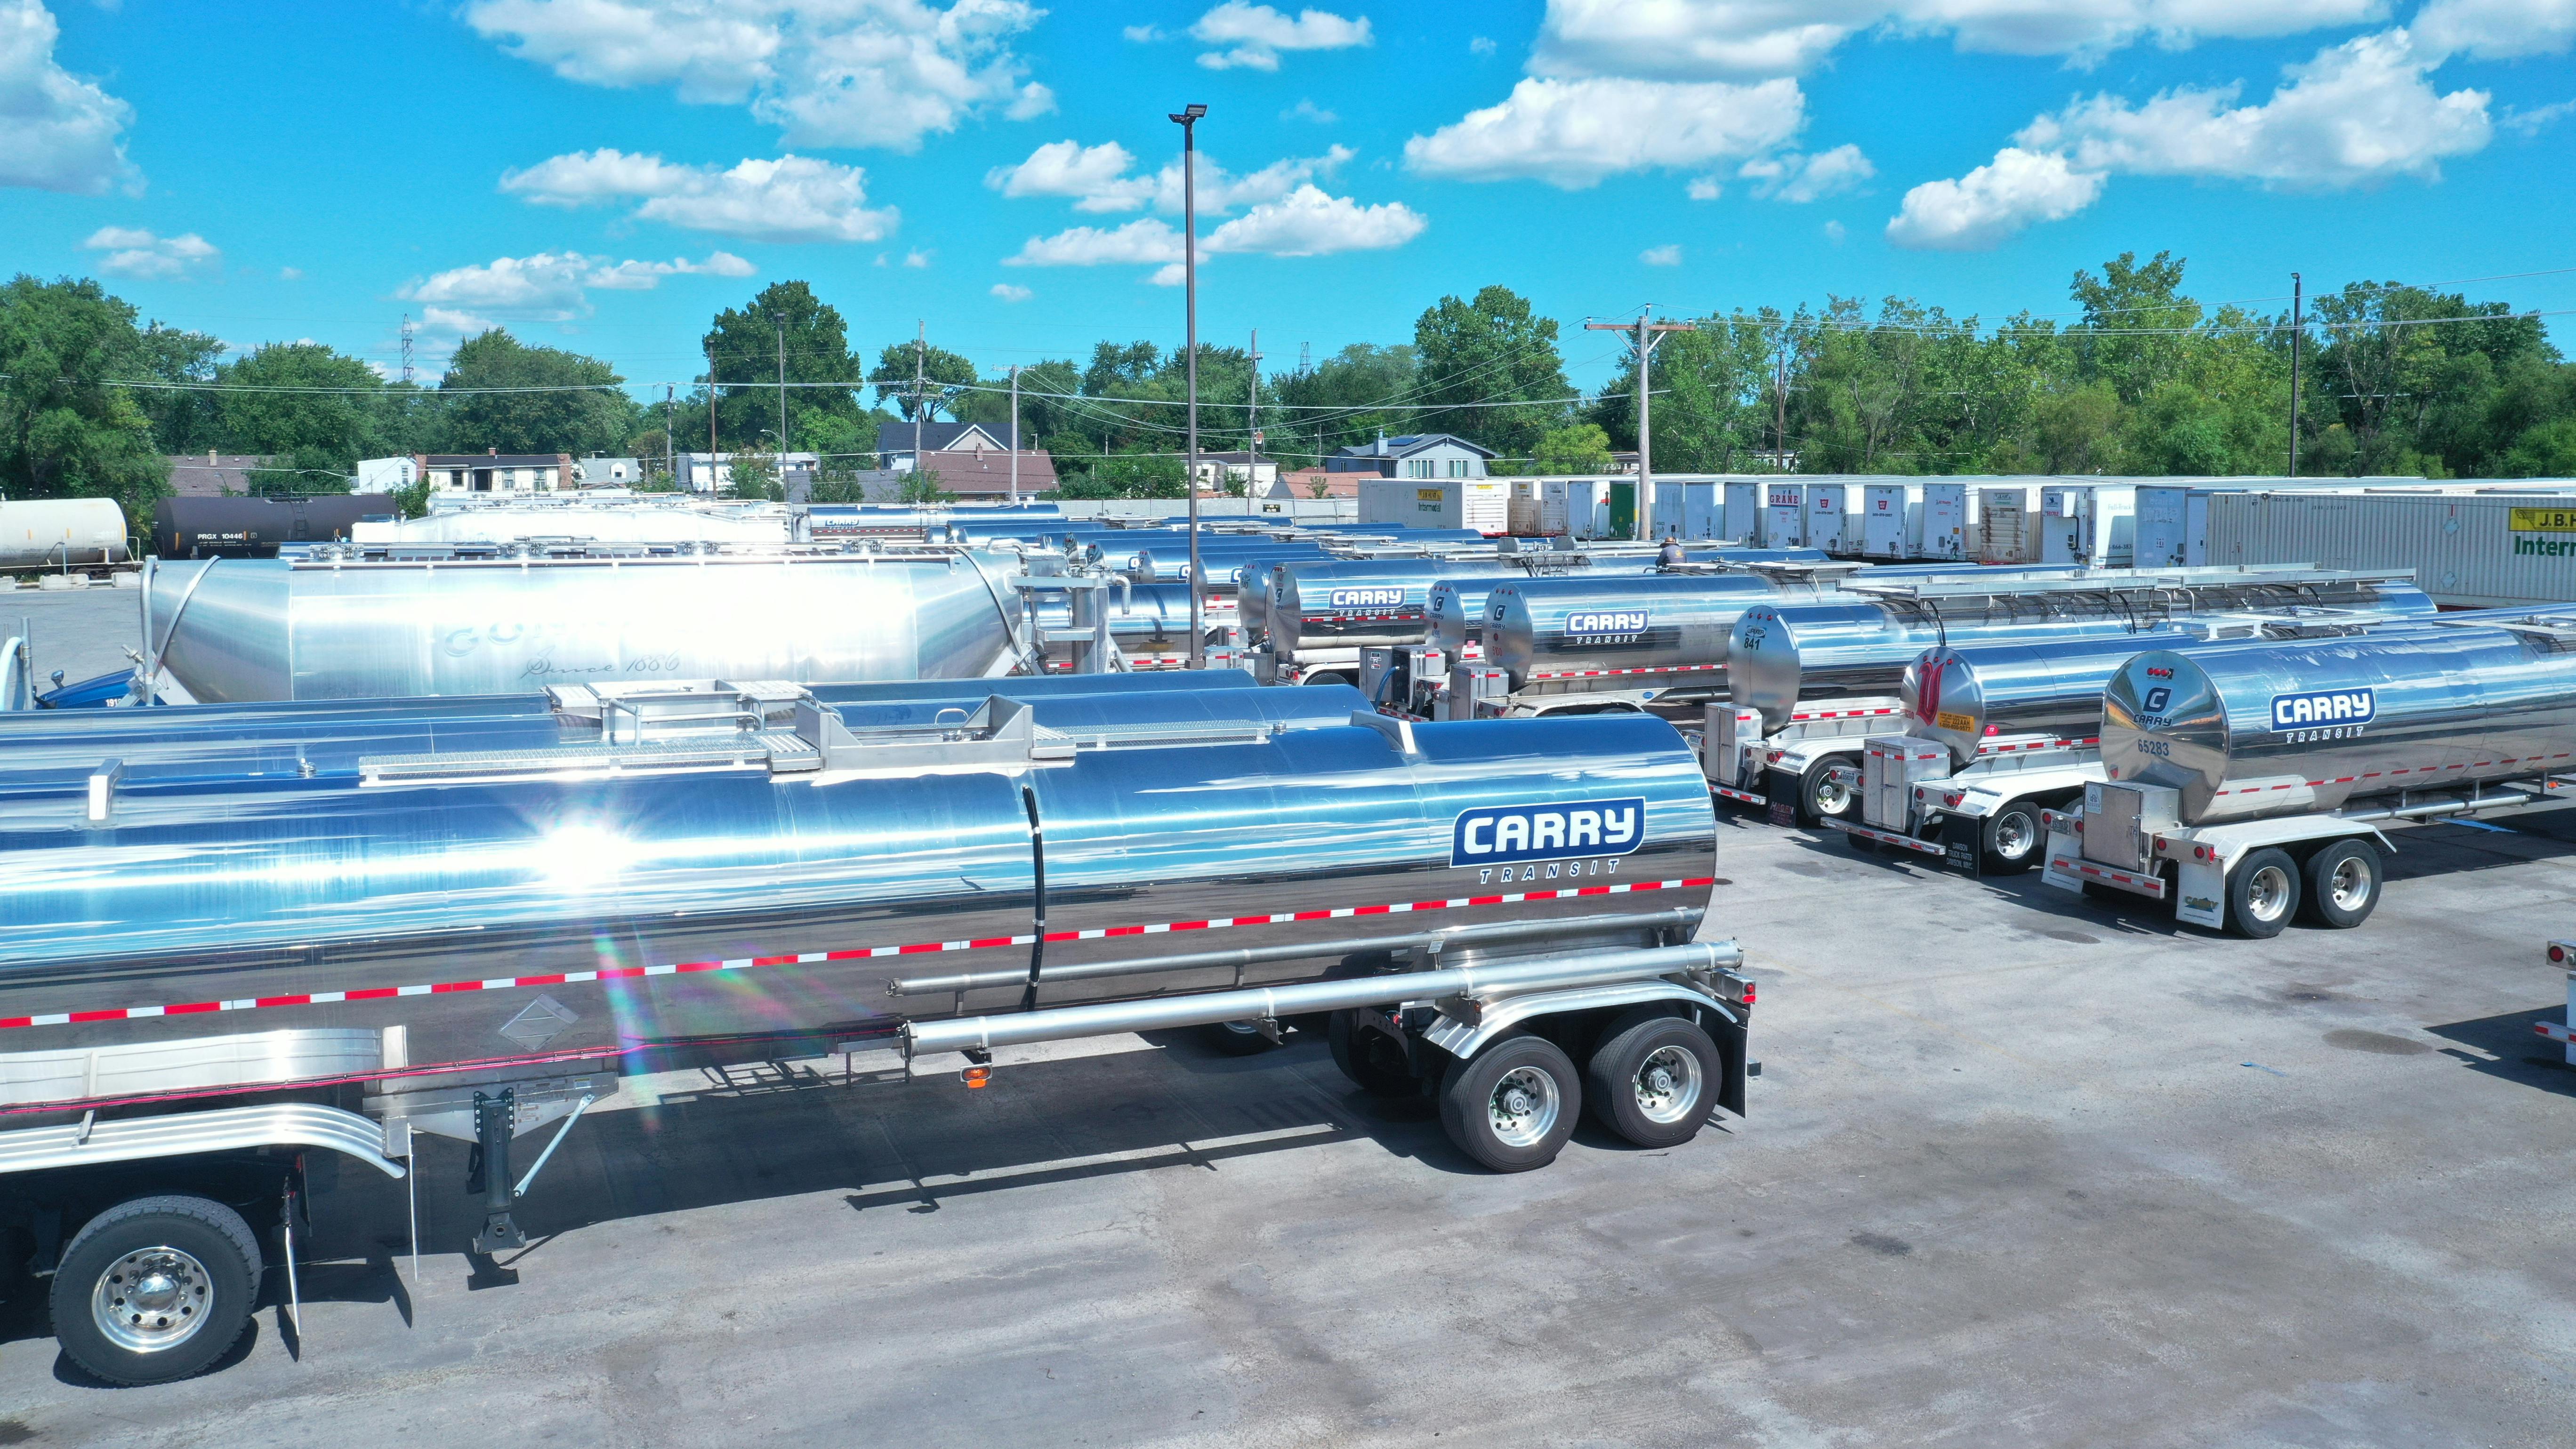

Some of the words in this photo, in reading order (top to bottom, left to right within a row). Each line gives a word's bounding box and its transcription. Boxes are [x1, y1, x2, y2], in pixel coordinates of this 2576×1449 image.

[1418, 502, 1441, 512] Intermodal
[1770, 495, 1798, 504] GRANE
[1333, 590, 1402, 605] CARRY
[1570, 613, 1644, 631] CARRY
[1577, 635, 1637, 644] TRANSIT
[1744, 637, 1760, 650] 841
[521, 645, 616, 679] Since
[626, 648, 681, 672] 1886
[2276, 693, 2370, 724] CARRY
[2133, 714, 2173, 727] CARRY
[2286, 726, 2363, 743] TRANSIT
[2138, 739, 2169, 757] 65283
[1770, 801, 1794, 815] HAGEN
[1464, 807, 1635, 854] CARRY
[1480, 859, 1620, 885] TRANSIT
